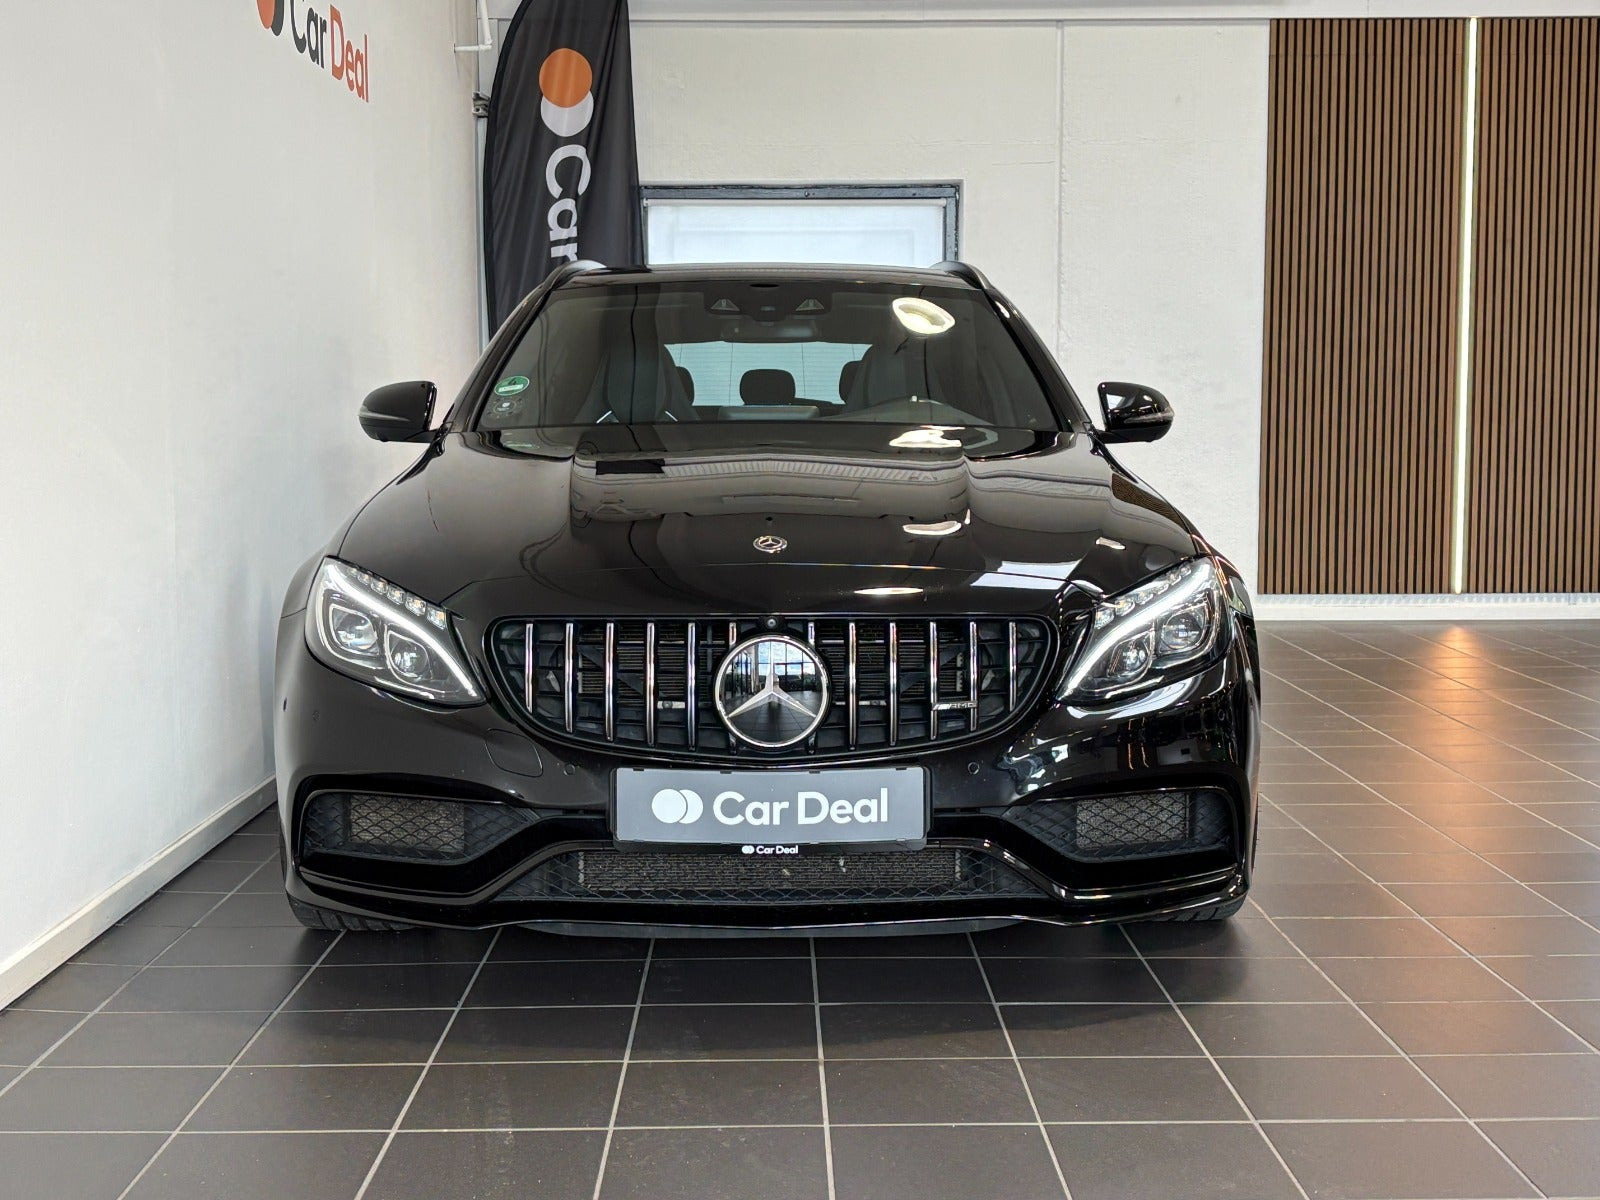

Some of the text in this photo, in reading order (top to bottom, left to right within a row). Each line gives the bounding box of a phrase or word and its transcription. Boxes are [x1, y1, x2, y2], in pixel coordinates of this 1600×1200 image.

[290, 0, 369, 103] Car Deal
[545, 144, 592, 261] Car
[713, 787, 888, 825] Car Deal
[756, 845, 799, 854] Car Deal
